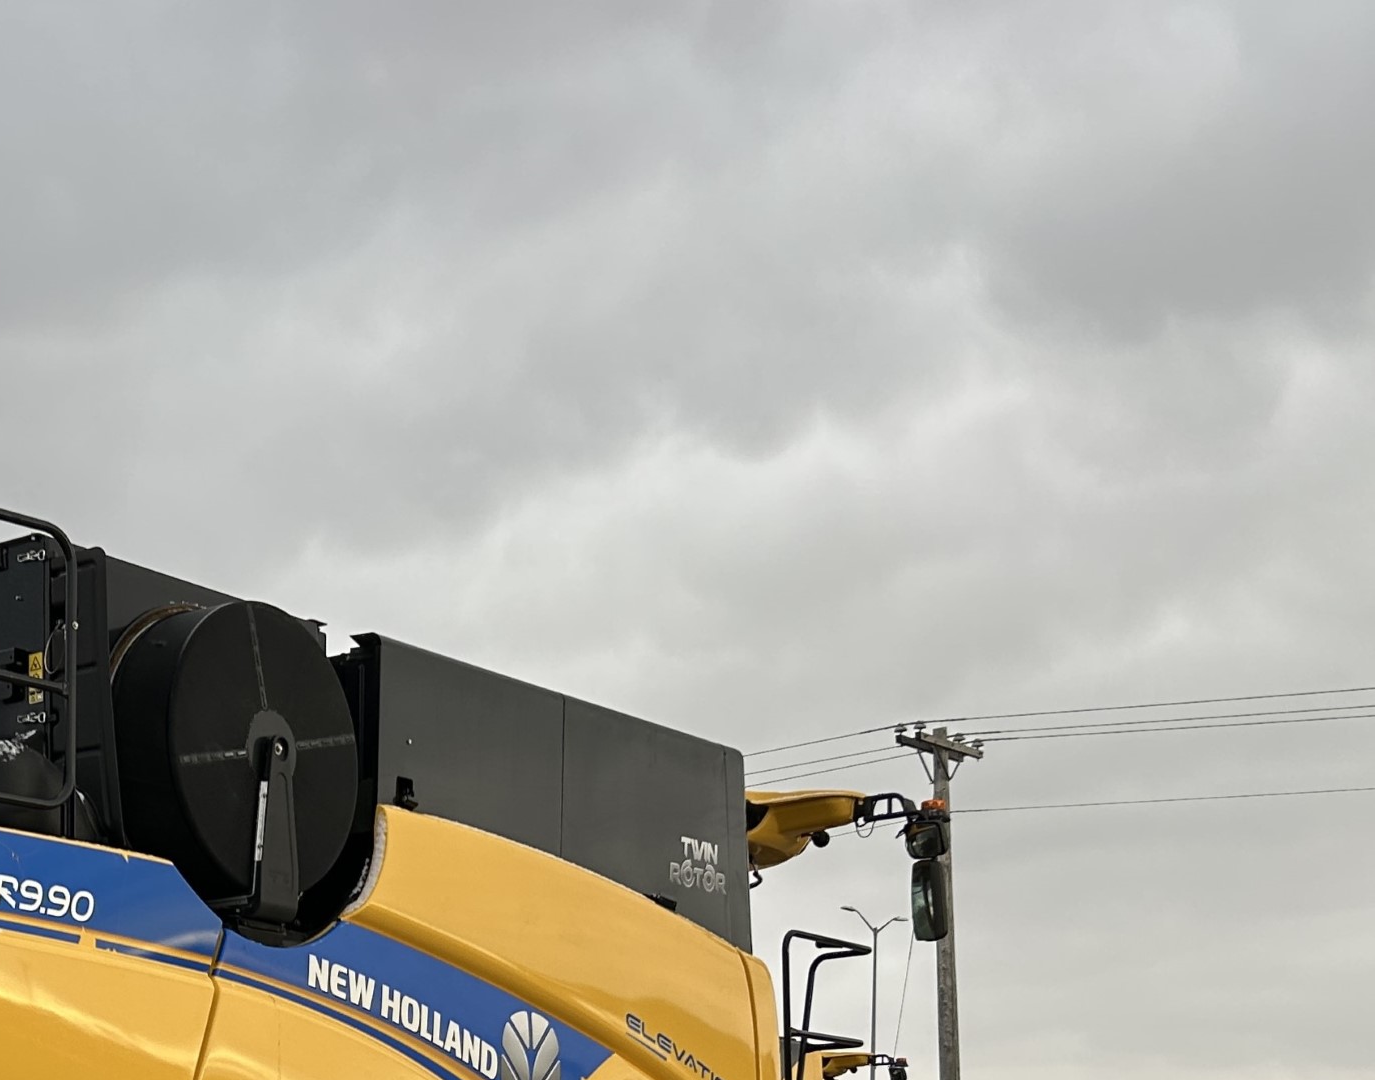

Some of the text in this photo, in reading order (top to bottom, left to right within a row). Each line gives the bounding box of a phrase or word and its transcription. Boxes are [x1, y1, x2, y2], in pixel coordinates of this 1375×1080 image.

[681, 836, 718, 865] TWIN
[669, 859, 727, 895] ROTOR
[307, 953, 498, 1080] NEW HOLLAND
